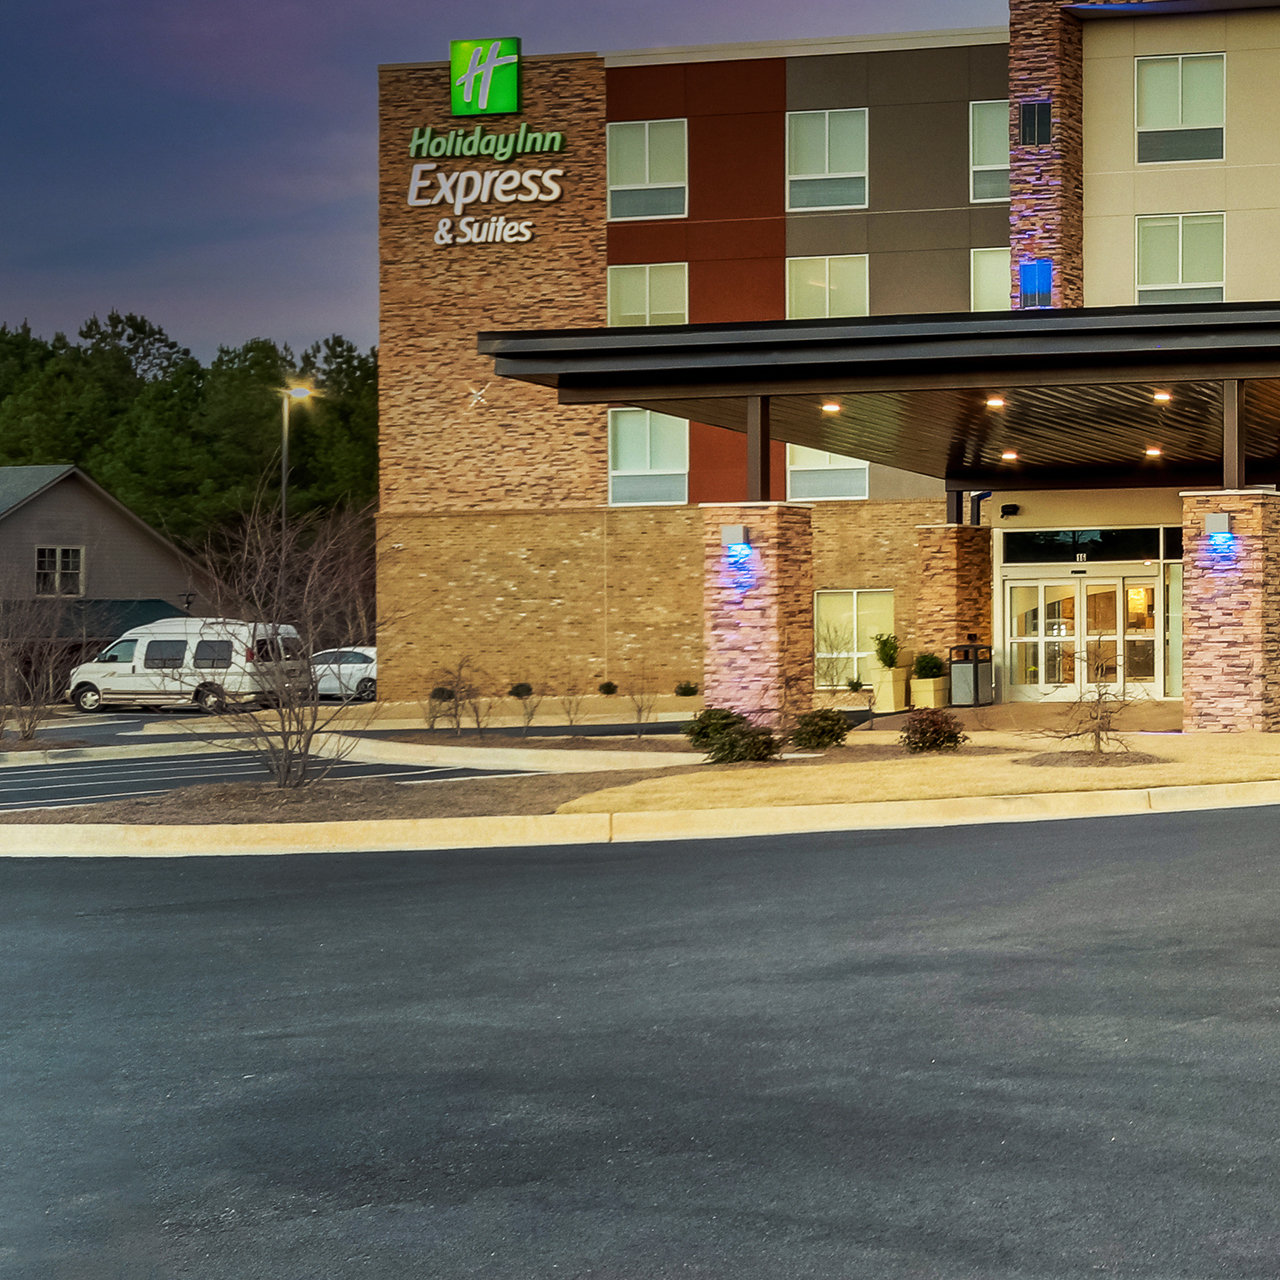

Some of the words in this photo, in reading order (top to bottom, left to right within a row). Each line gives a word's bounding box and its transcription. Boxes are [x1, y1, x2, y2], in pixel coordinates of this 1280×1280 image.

[408, 125, 516, 162] Holiday
[515, 123, 563, 153] Inn
[407, 163, 564, 216] Express
[434, 217, 454, 245] &
[456, 215, 533, 244] Suites
